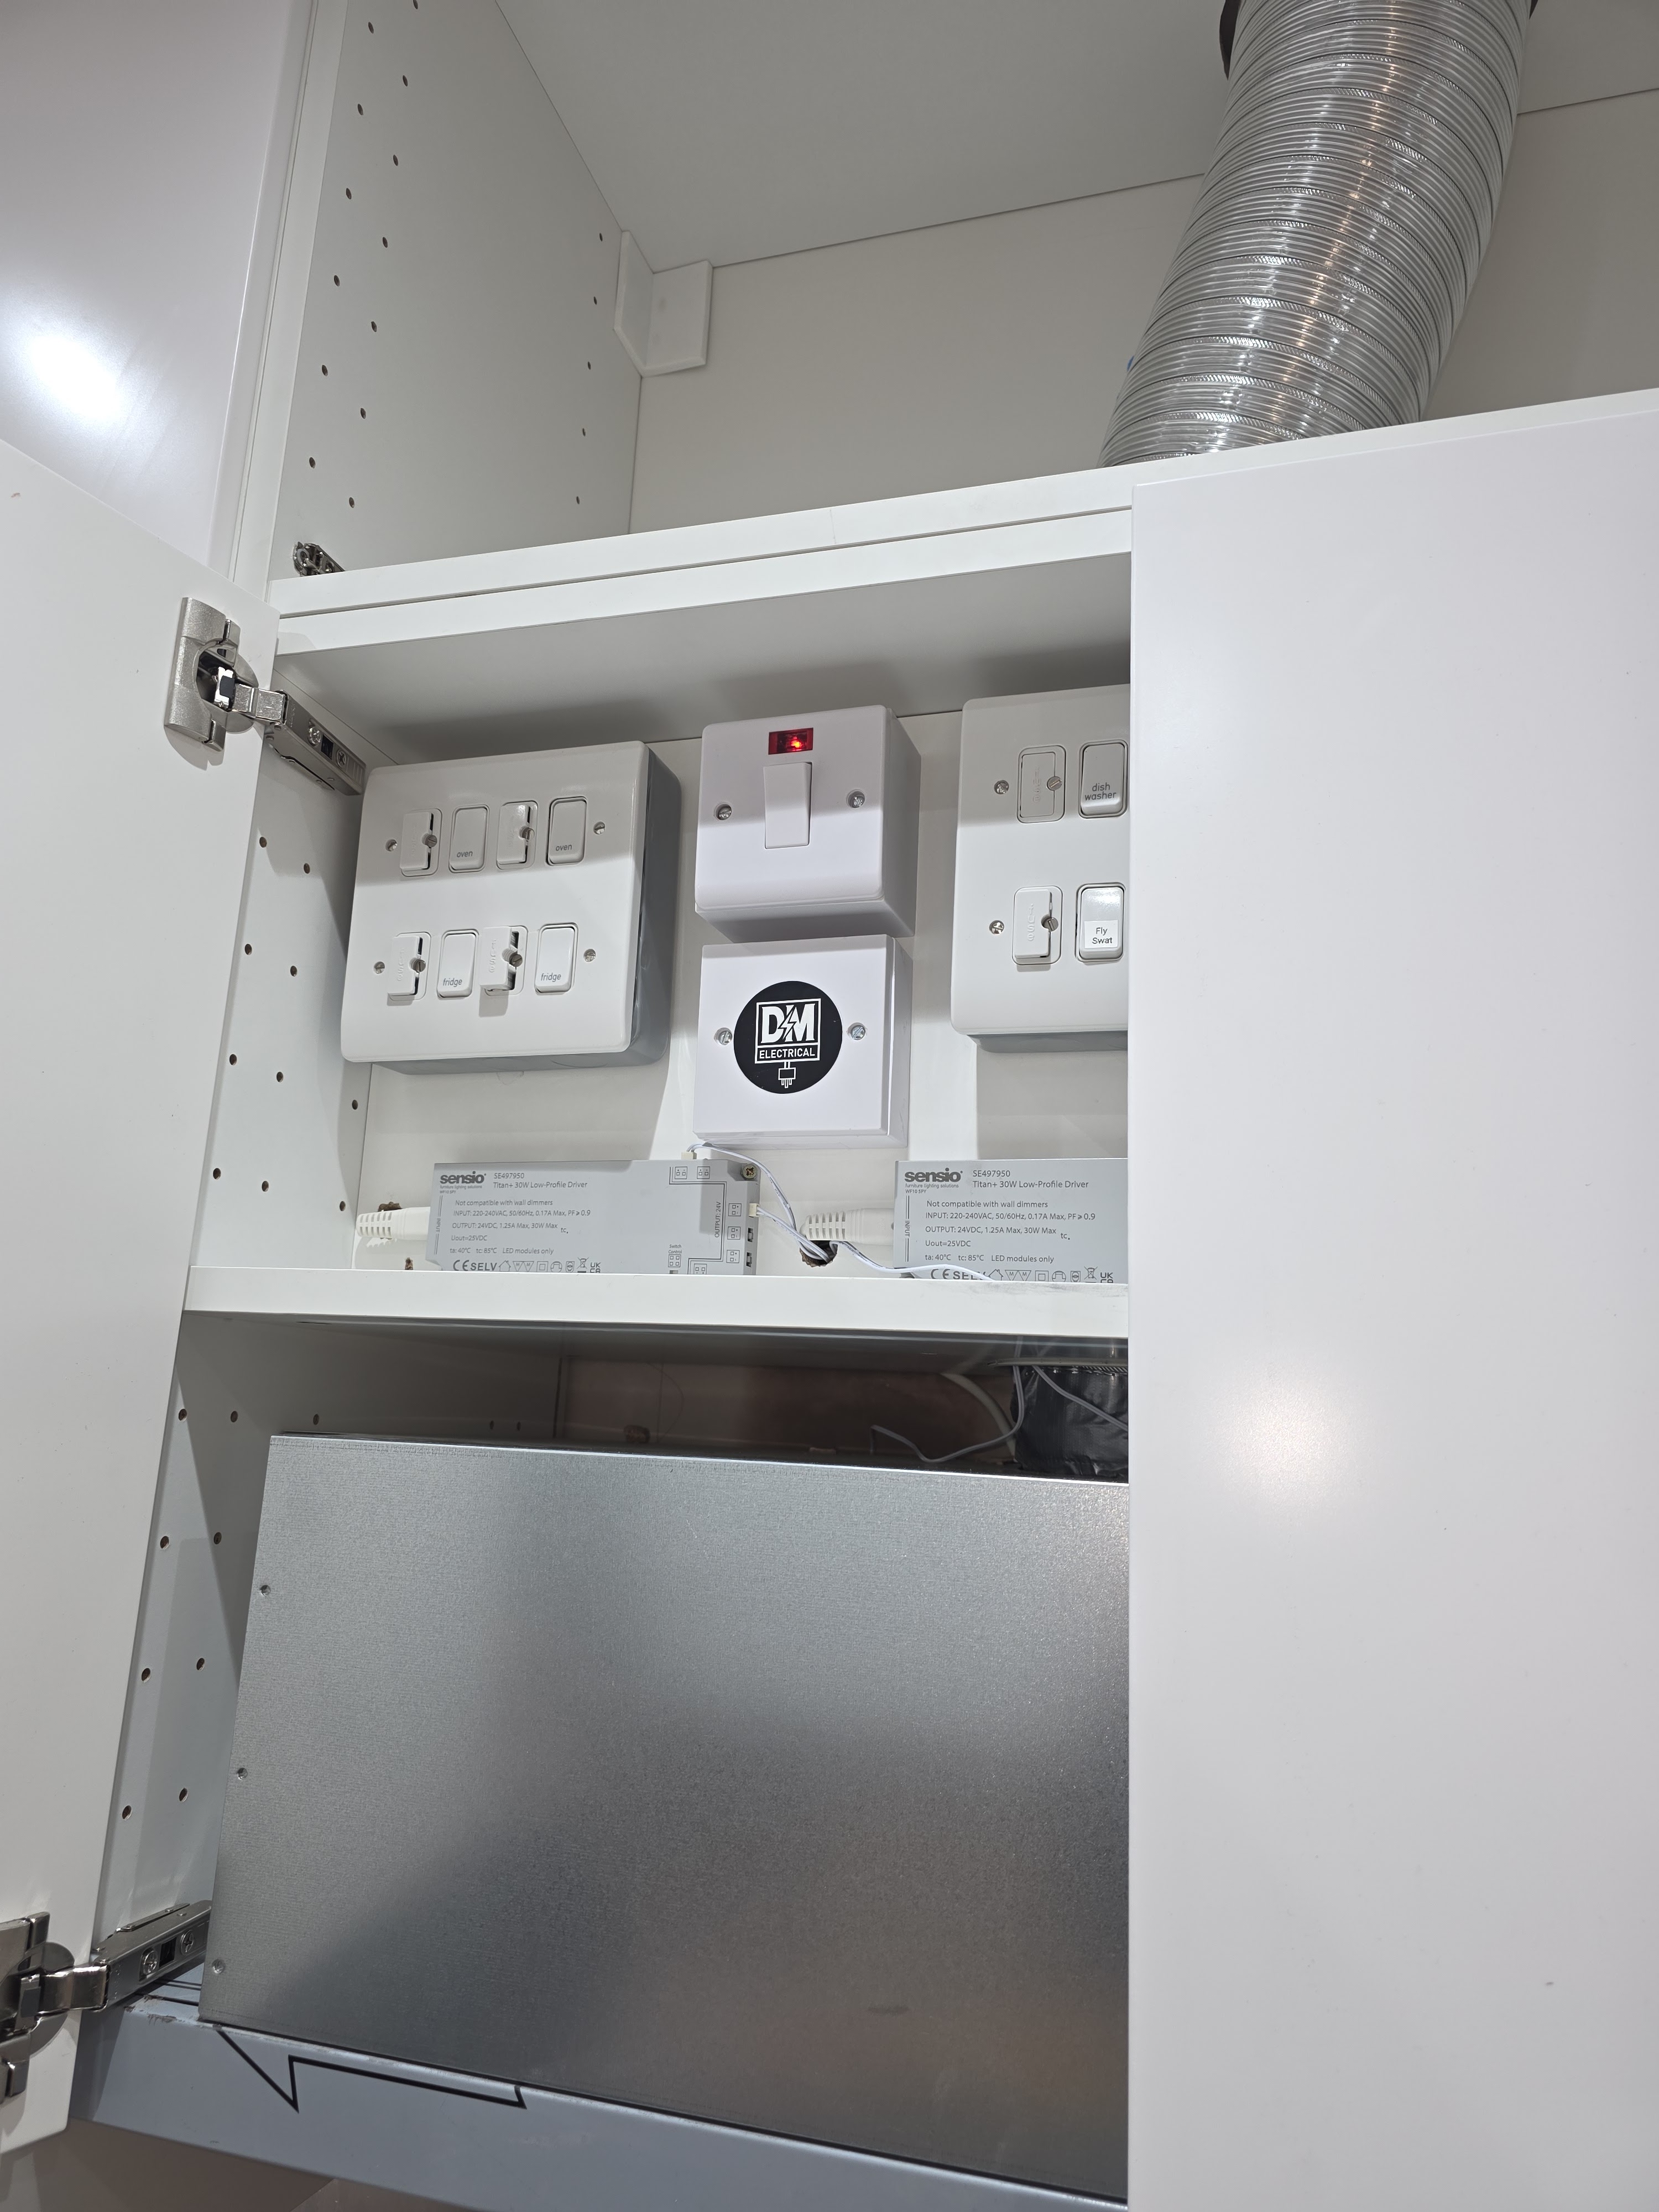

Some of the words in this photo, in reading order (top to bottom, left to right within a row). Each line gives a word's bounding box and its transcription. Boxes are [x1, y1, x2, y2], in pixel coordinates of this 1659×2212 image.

[1092, 782, 1110, 791] dish
[1084, 791, 1117, 801] washer
[1095, 927, 1108, 936] Fly
[442, 977, 462, 987] fridge
[540, 973, 561, 982] fridge
[759, 1047, 816, 1059] ELECTRICAL
[440, 1171, 484, 1184] sensio
[904, 1167, 961, 1183] sensio
[1019, 1180, 1063, 1188] Low-Profile
[466, 1199, 499, 1208] compatible
[941, 1201, 982, 1209] compatible
[1049, 1213, 1066, 1221] Max,
[957, 1226, 983, 1234] 24VDC,
[1005, 1227, 1022, 1235] Max,
[1039, 1255, 1055, 1264] only
[470, 1262, 498, 1271] SELV
